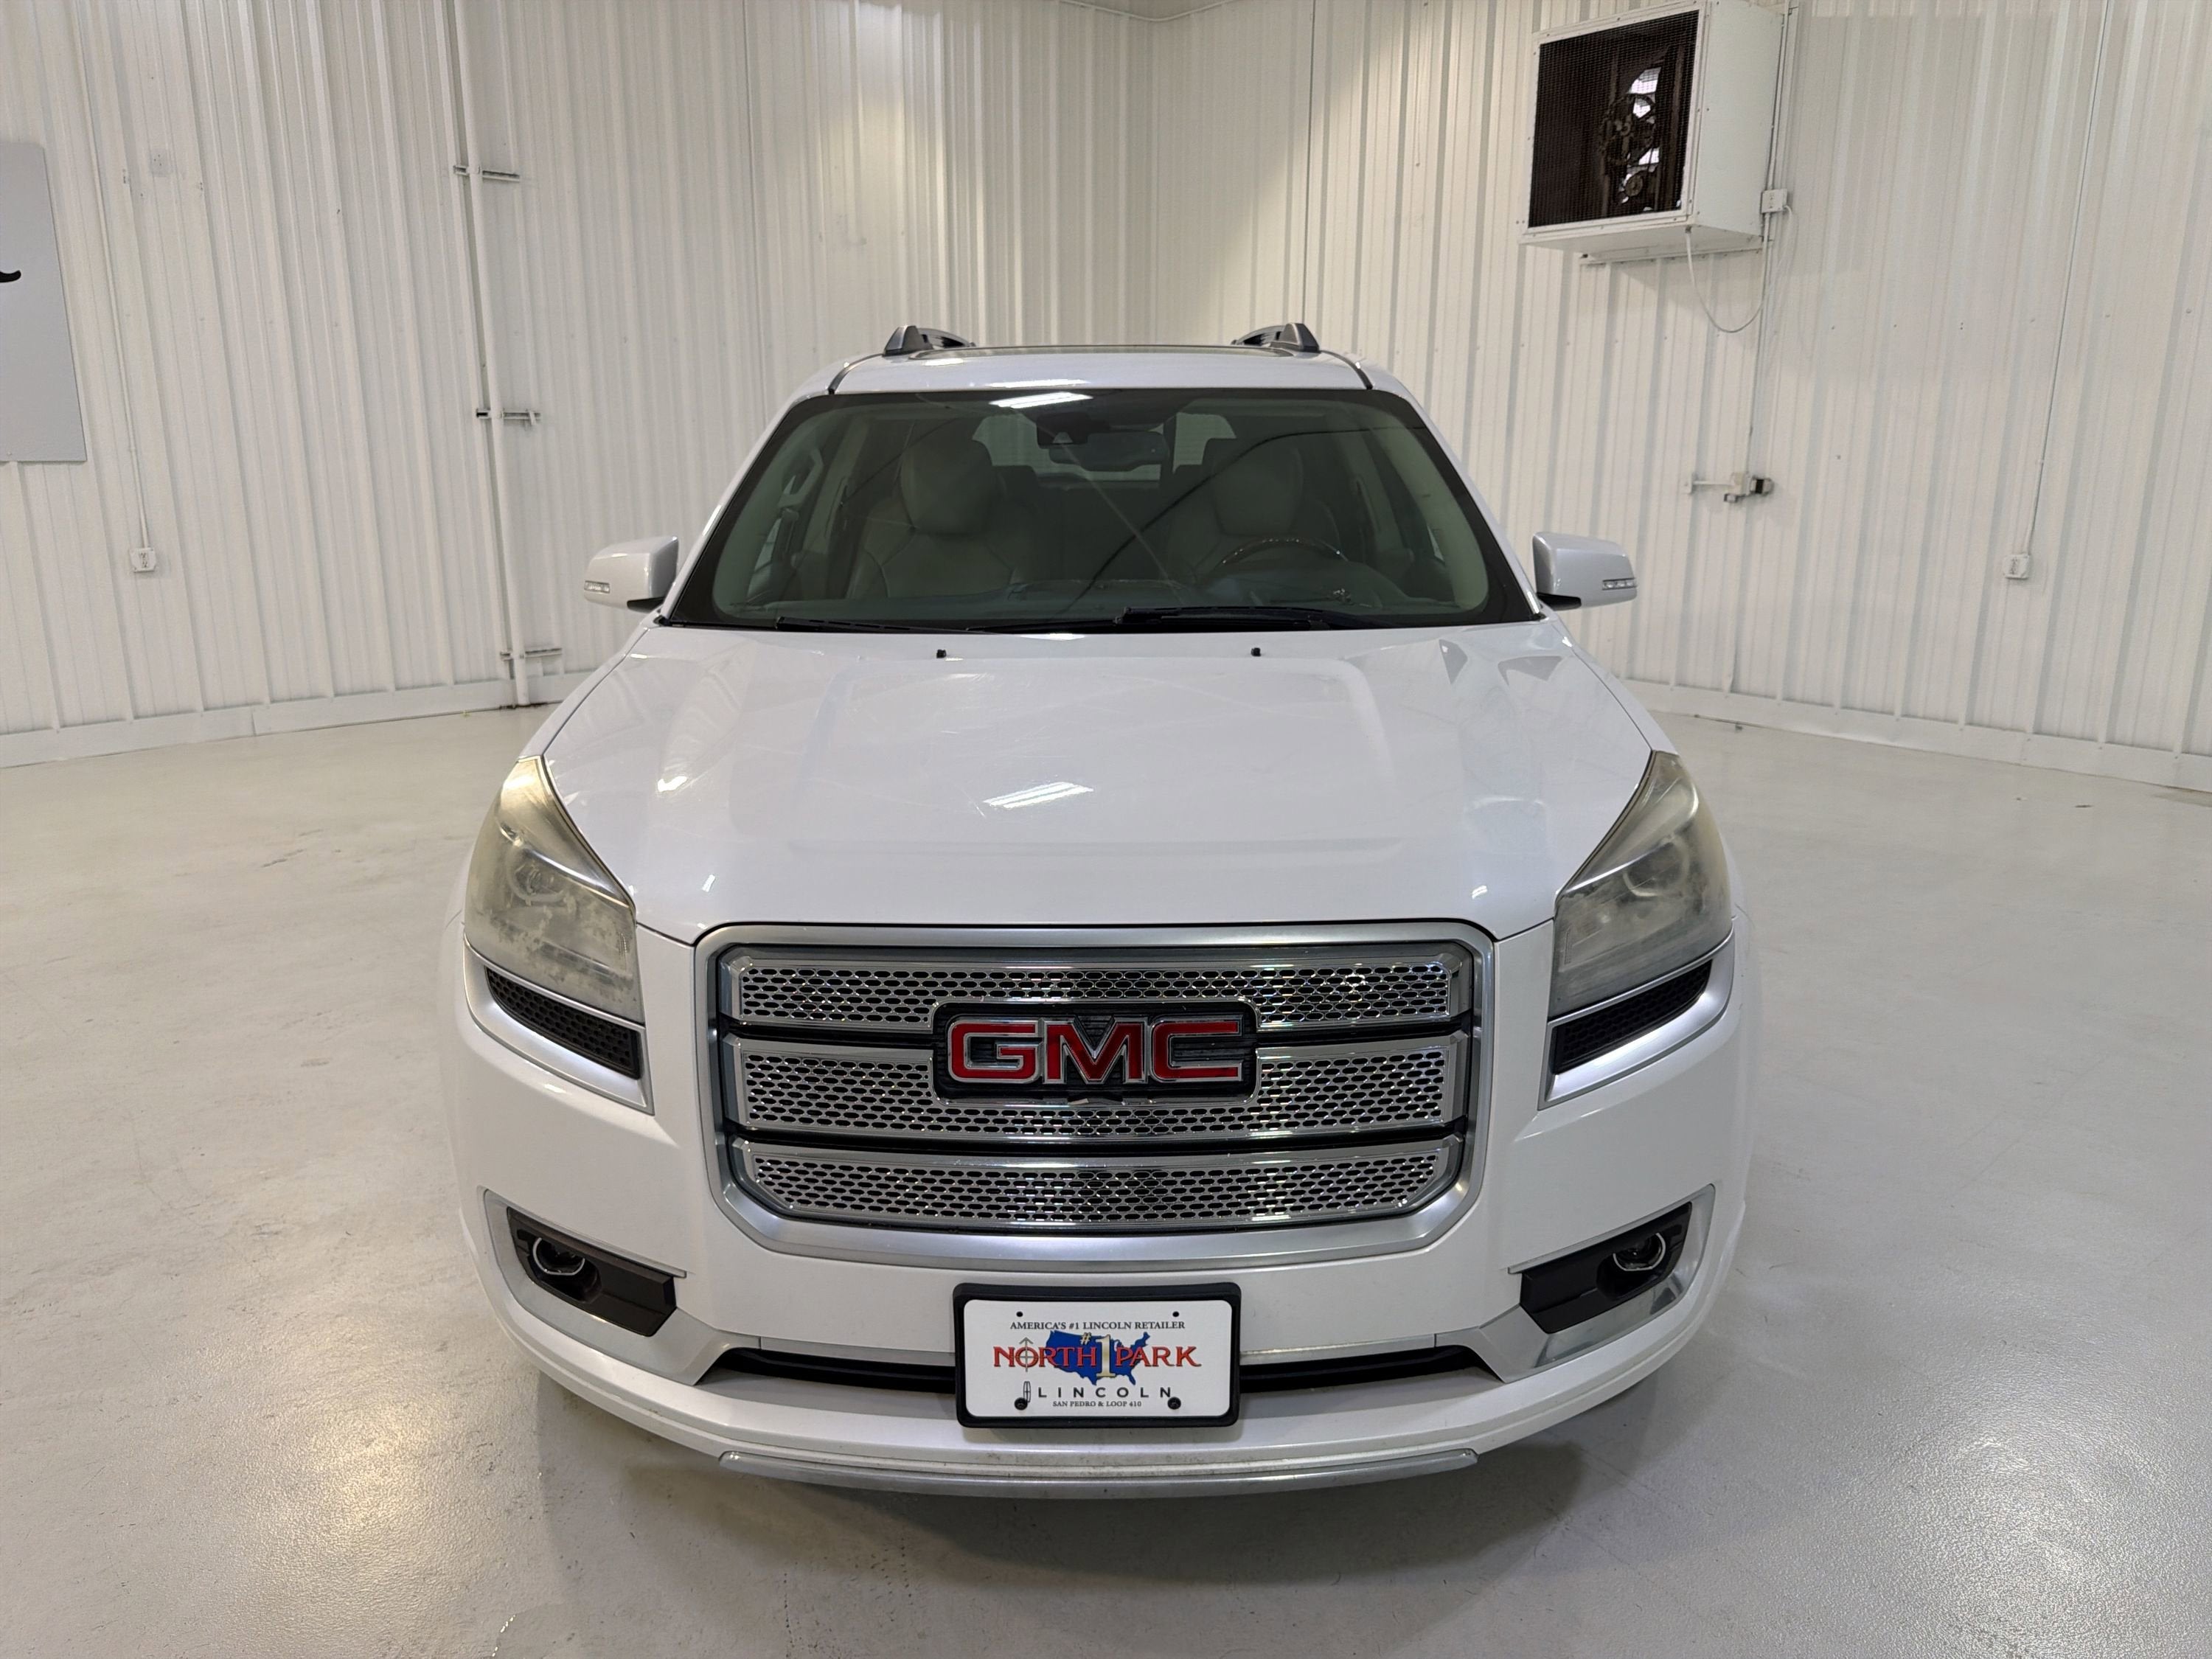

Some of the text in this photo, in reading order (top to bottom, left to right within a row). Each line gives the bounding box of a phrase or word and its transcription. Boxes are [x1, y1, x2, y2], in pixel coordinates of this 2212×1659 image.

[947, 1015, 1244, 1084] GMC
[1082, 1321, 1132, 1329] LINCOLN
[1135, 1321, 1186, 1329] RETAILER
[993, 1346, 1202, 1367] NORTH PARK
[1038, 1387, 1171, 1398] LINCOLN
